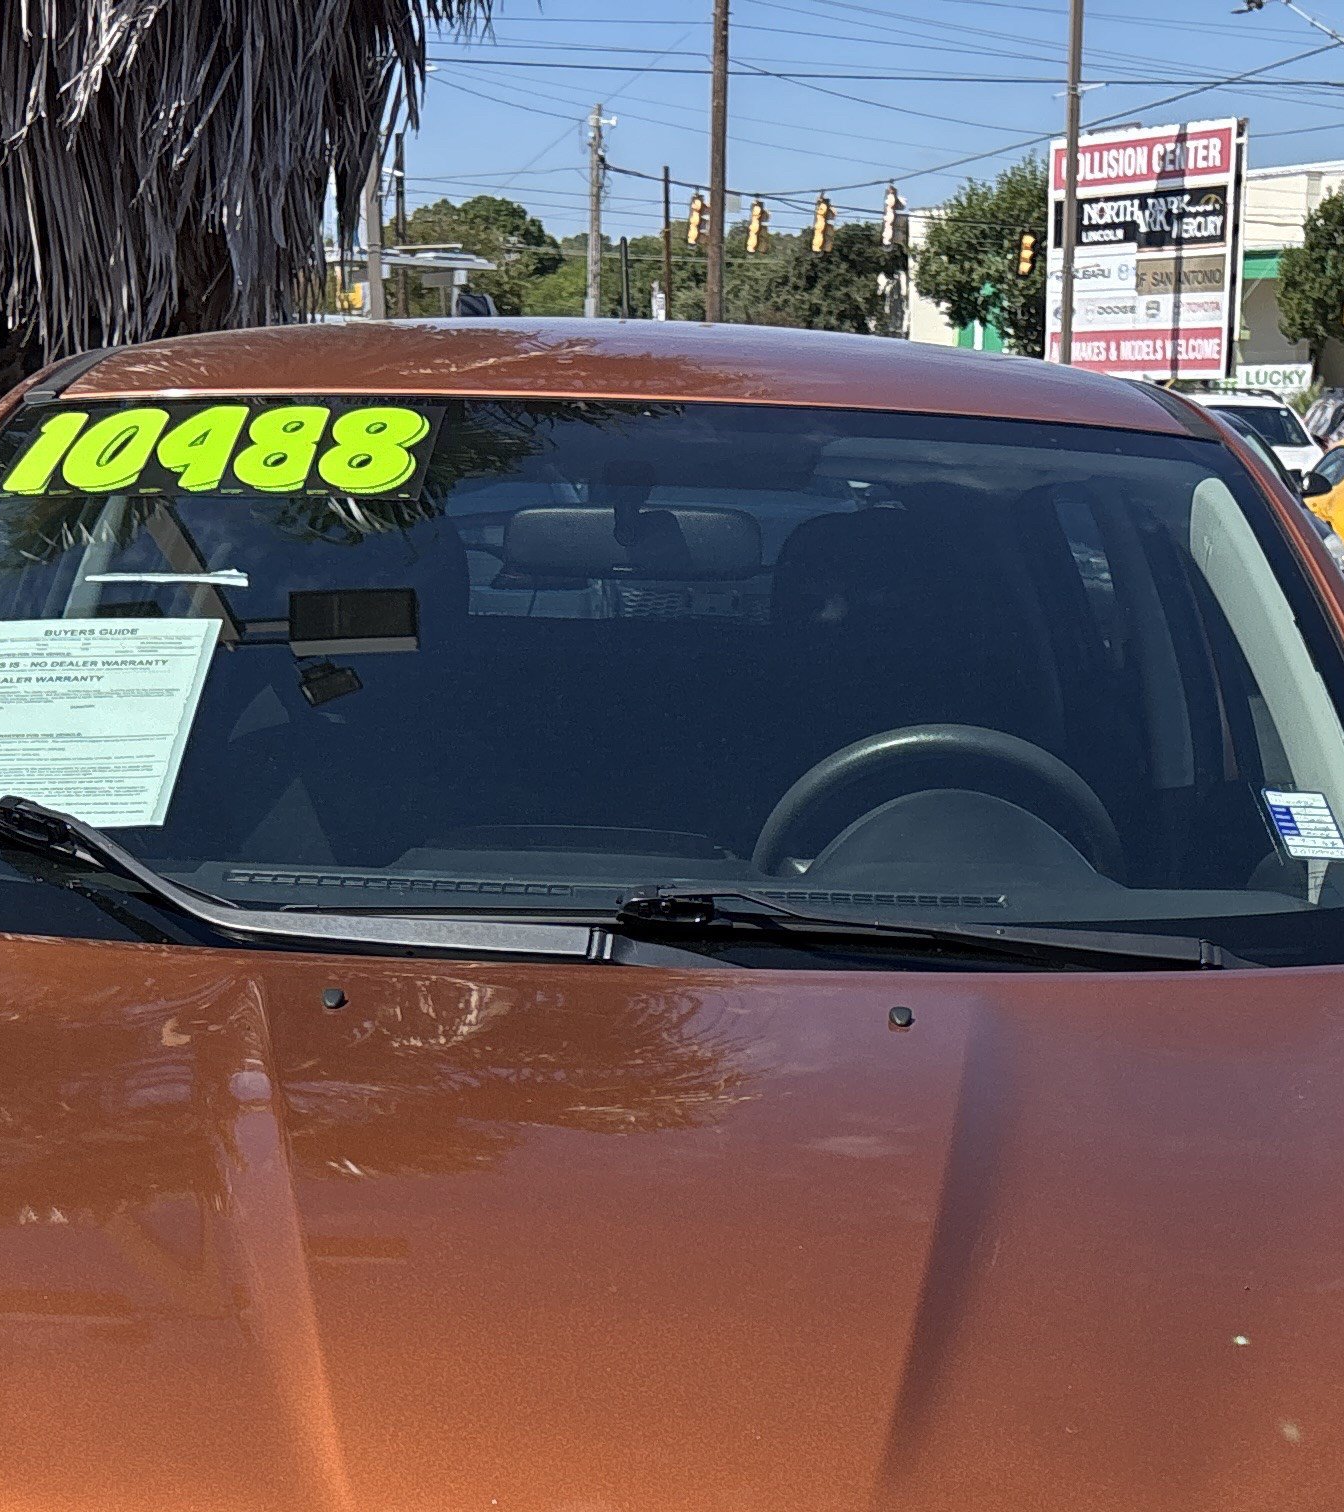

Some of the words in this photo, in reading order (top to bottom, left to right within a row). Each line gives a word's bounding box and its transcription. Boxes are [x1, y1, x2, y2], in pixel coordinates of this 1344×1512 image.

[1152, 137, 1222, 173] CENTER
[1082, 199, 1140, 226] NORTH
[1081, 228, 1124, 242] LINCOLN
[1151, 270, 1174, 287] SAN
[1245, 369, 1307, 386] LUCKY
[2, 405, 430, 495] 10488
[43, 628, 96, 637] BUYERS
[98, 628, 139, 636] GUIDE
[9, 661, 21, 669] IS
[50, 660, 98, 668] DEALER
[101, 659, 169, 667] WARRANTY
[35, 674, 104, 683] WARRANTY
